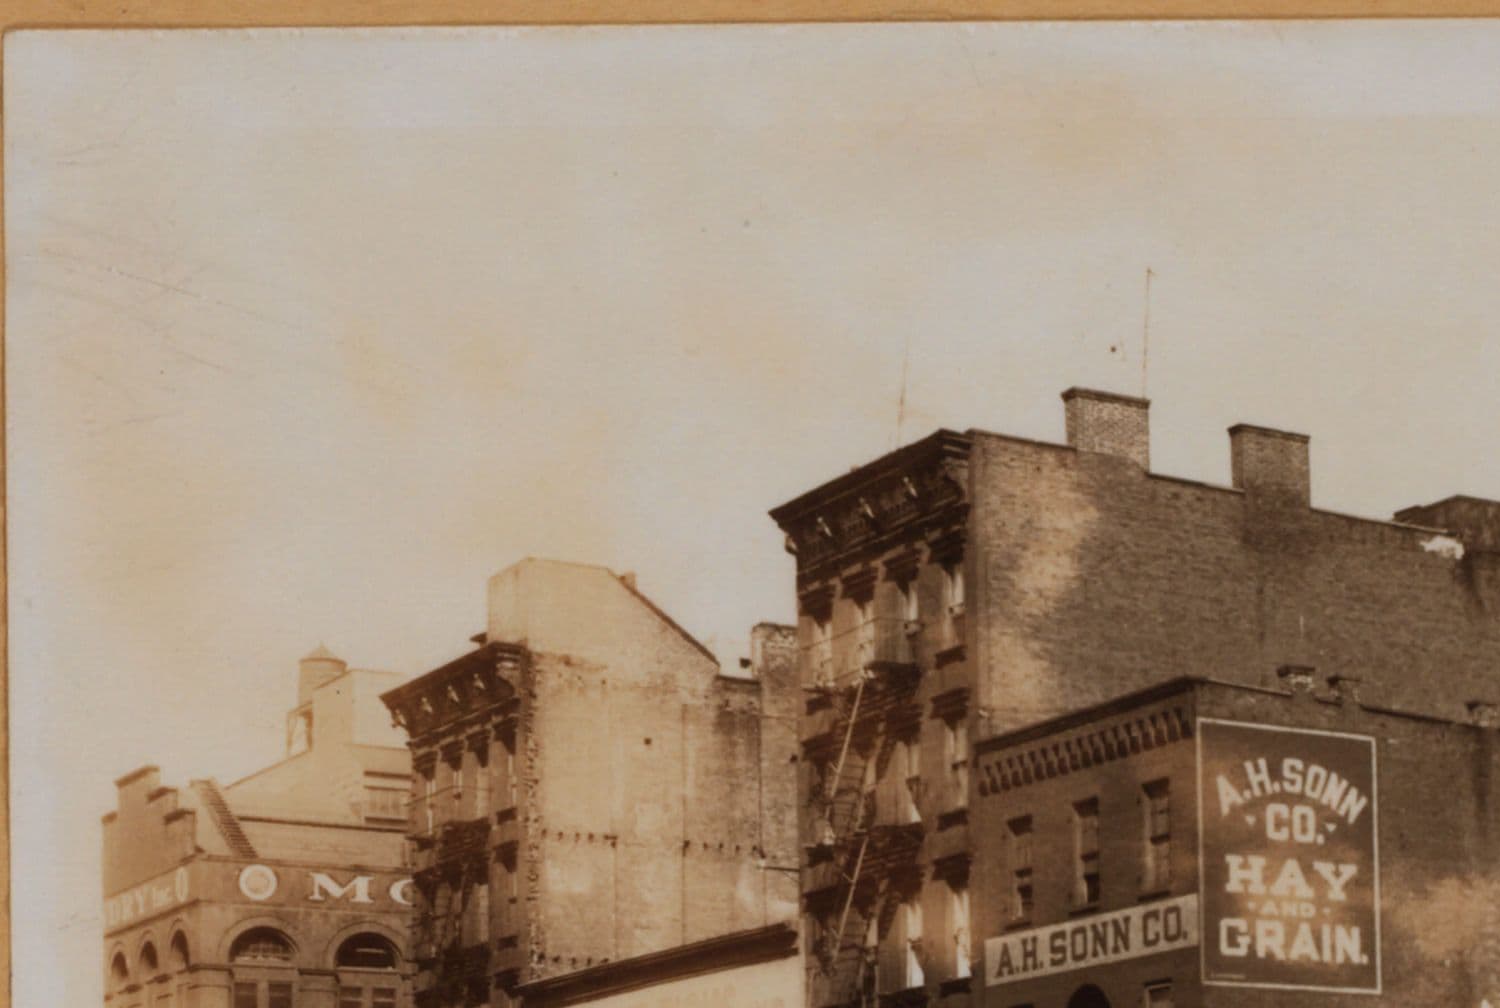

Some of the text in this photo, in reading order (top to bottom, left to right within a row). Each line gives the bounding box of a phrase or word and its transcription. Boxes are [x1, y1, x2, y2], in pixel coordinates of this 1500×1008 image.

[1265, 803, 1325, 845] CO.
[1225, 854, 1358, 901] HAY
[1260, 901, 1317, 918] AND
[1050, 915, 1131, 967] SONN
[1142, 905, 1188, 947] CO.
[1219, 918, 1369, 965] GRAIN.
